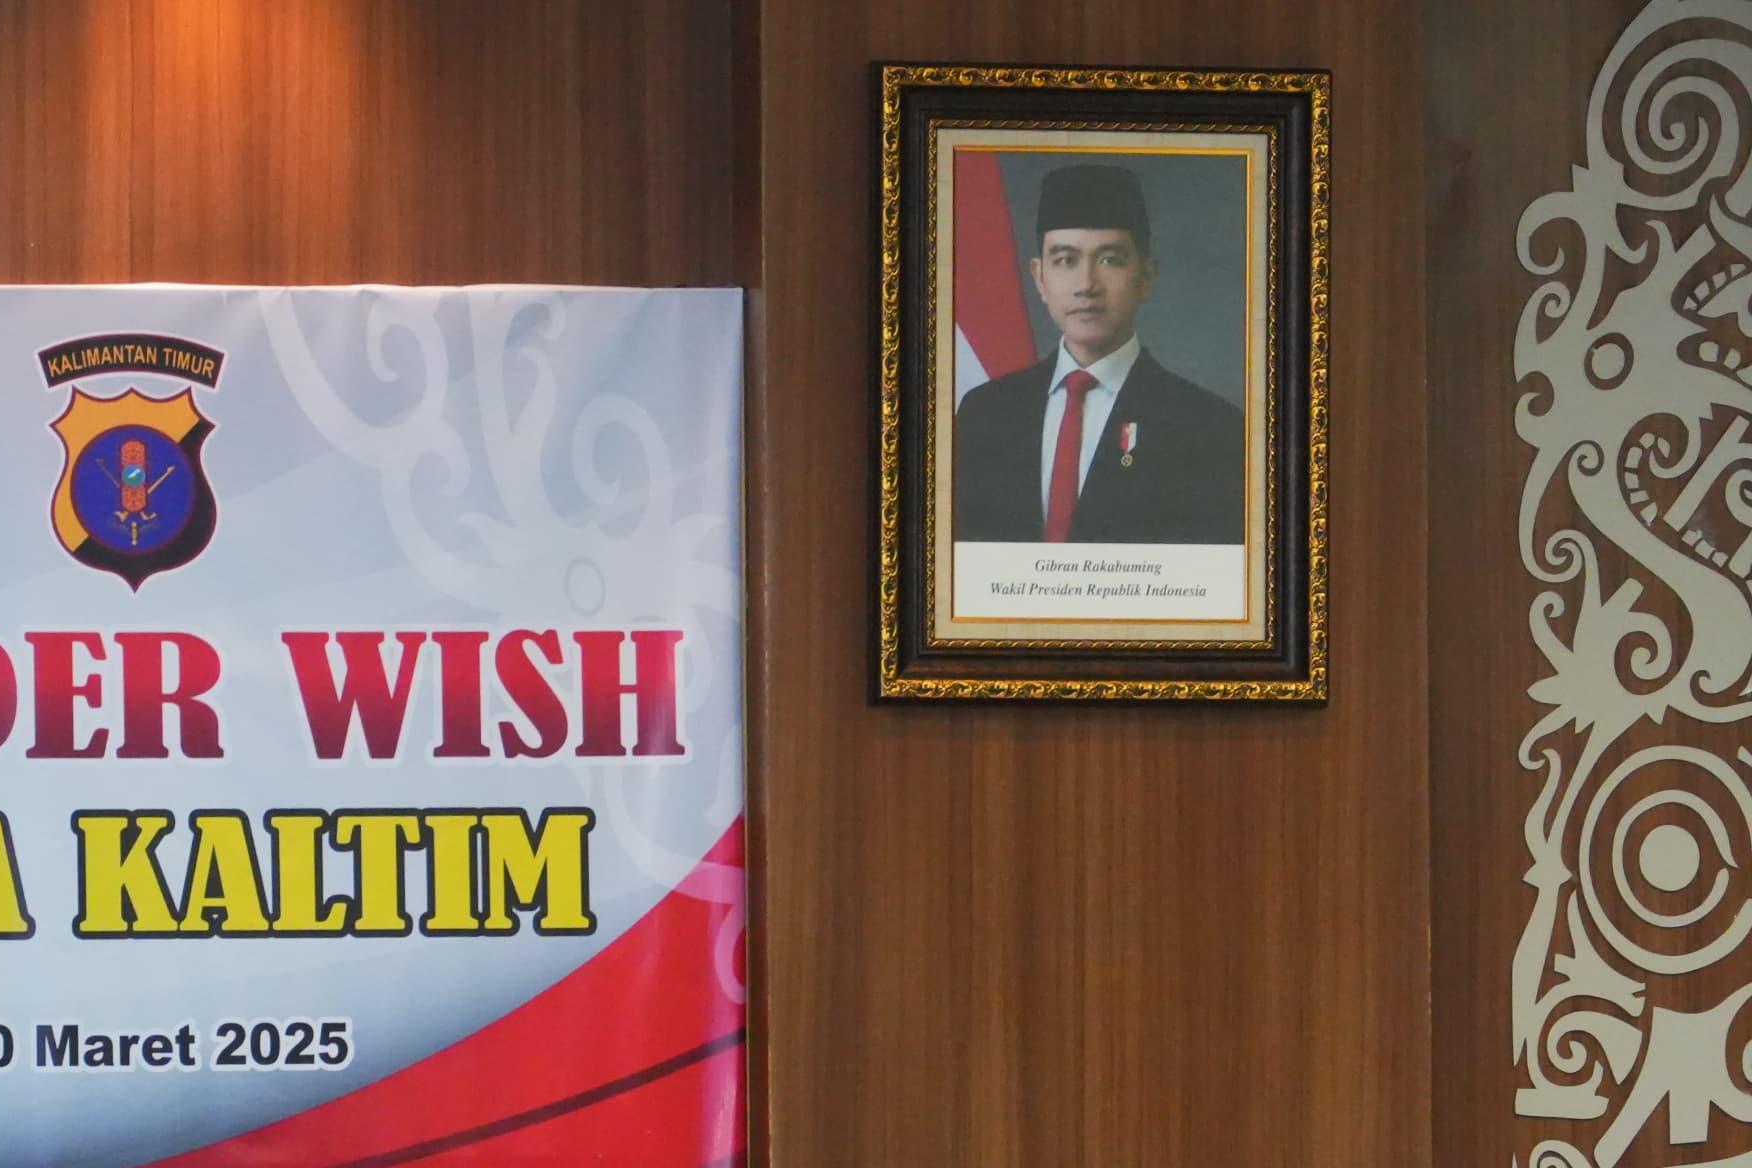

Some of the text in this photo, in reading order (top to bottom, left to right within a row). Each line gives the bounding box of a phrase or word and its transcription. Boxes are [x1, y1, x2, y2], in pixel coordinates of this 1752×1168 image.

[48, 344, 216, 378] KALIMANTAN TIMUR
[1034, 559, 1162, 576] Gibran Rakabuming
[990, 582, 1207, 599] Wakil Presiden Republik Indonesia
[281, 628, 686, 760] WISH
[70, 807, 597, 940] KALTIM
[35, 1024, 197, 1068] Maret
[214, 1021, 350, 1068] 2025
